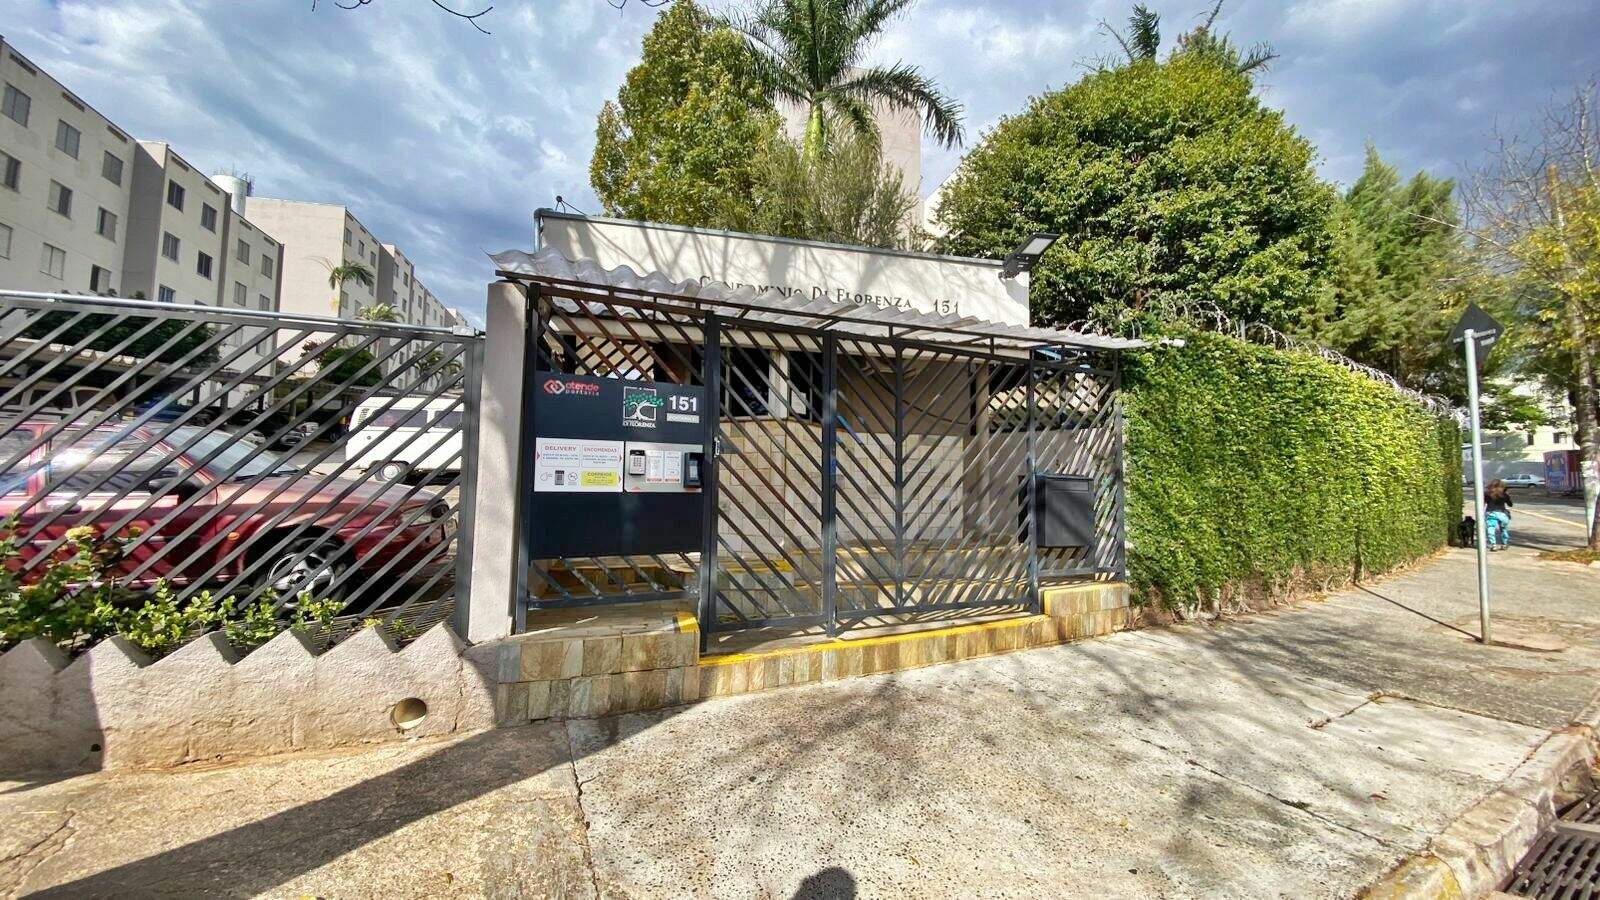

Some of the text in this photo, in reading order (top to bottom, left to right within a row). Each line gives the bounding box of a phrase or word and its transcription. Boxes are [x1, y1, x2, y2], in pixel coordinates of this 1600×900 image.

[699, 275, 803, 299] CNMNIO
[837, 288, 912, 308] FLORENZA
[933, 298, 959, 314] 151
[669, 395, 697, 412] 151
